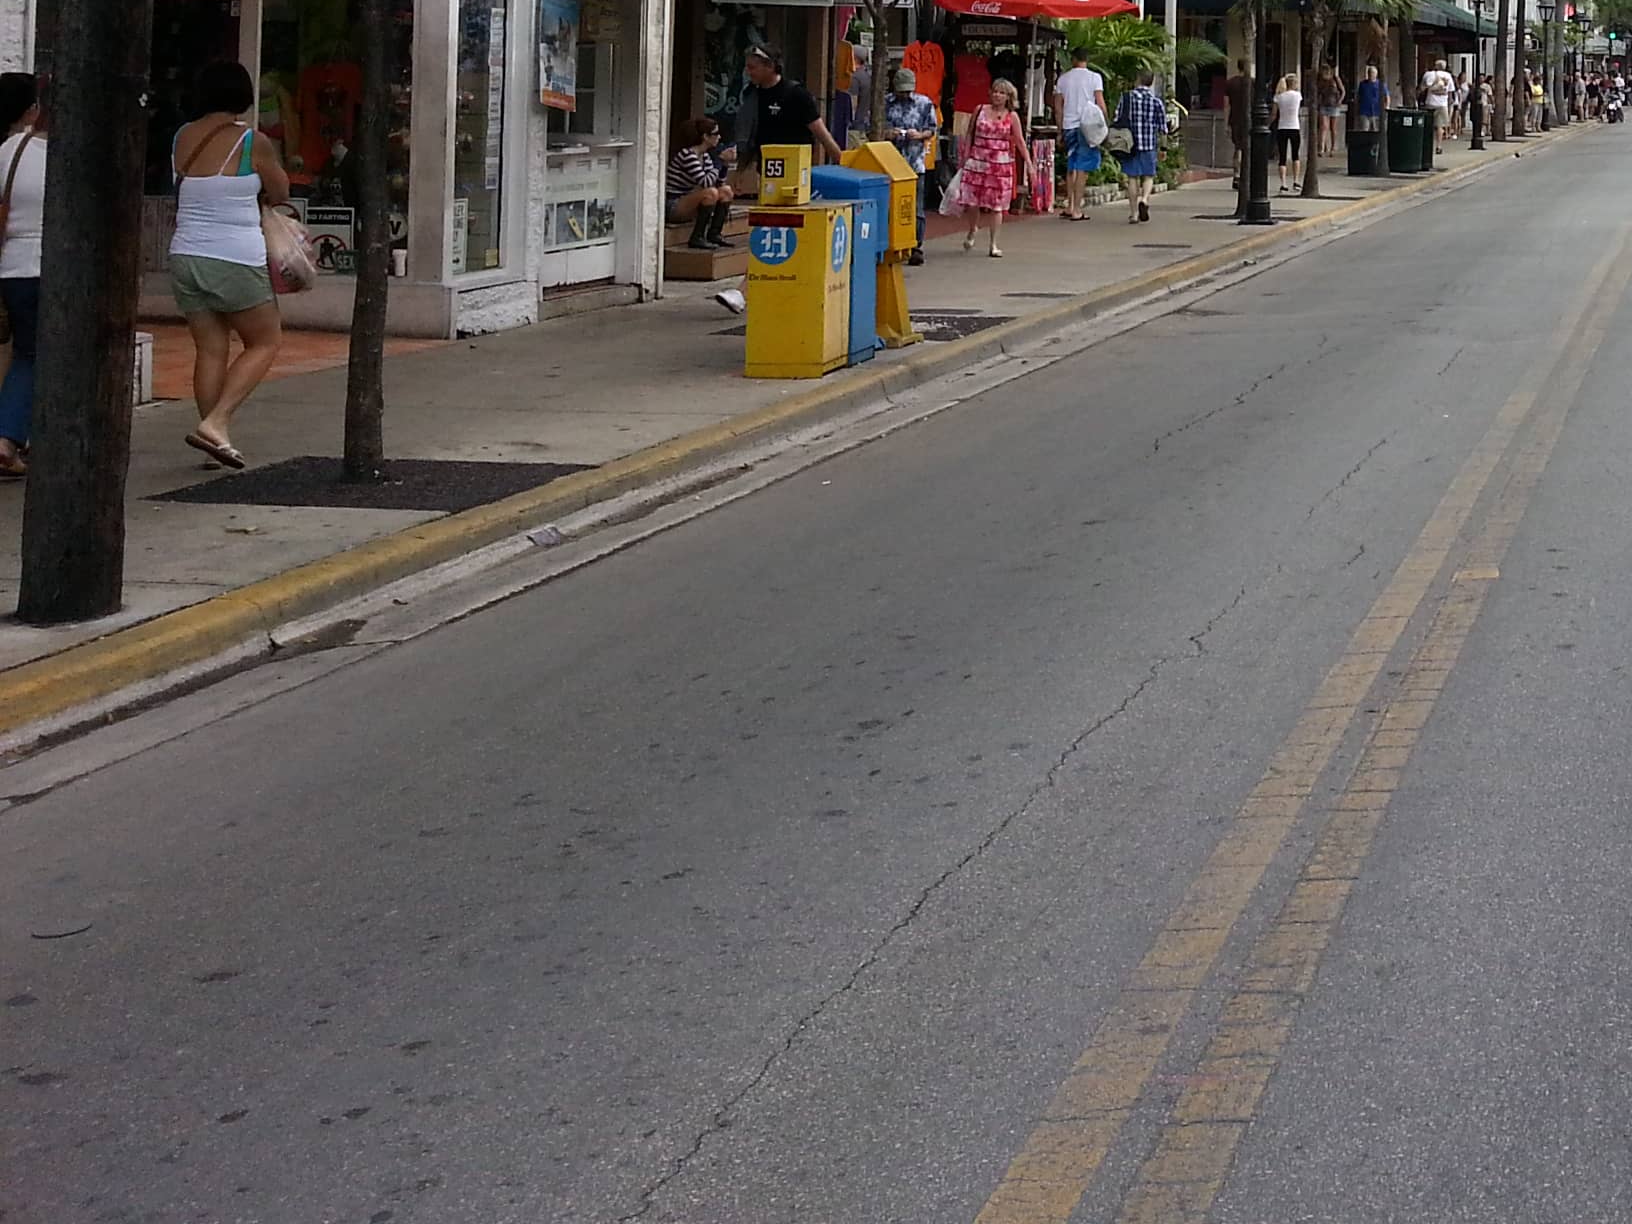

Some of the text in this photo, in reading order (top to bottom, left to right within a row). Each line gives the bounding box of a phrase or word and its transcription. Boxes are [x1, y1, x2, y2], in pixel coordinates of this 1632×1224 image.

[909, 48, 935, 63] KEY
[766, 160, 783, 177] 55
[759, 226, 789, 258] H
